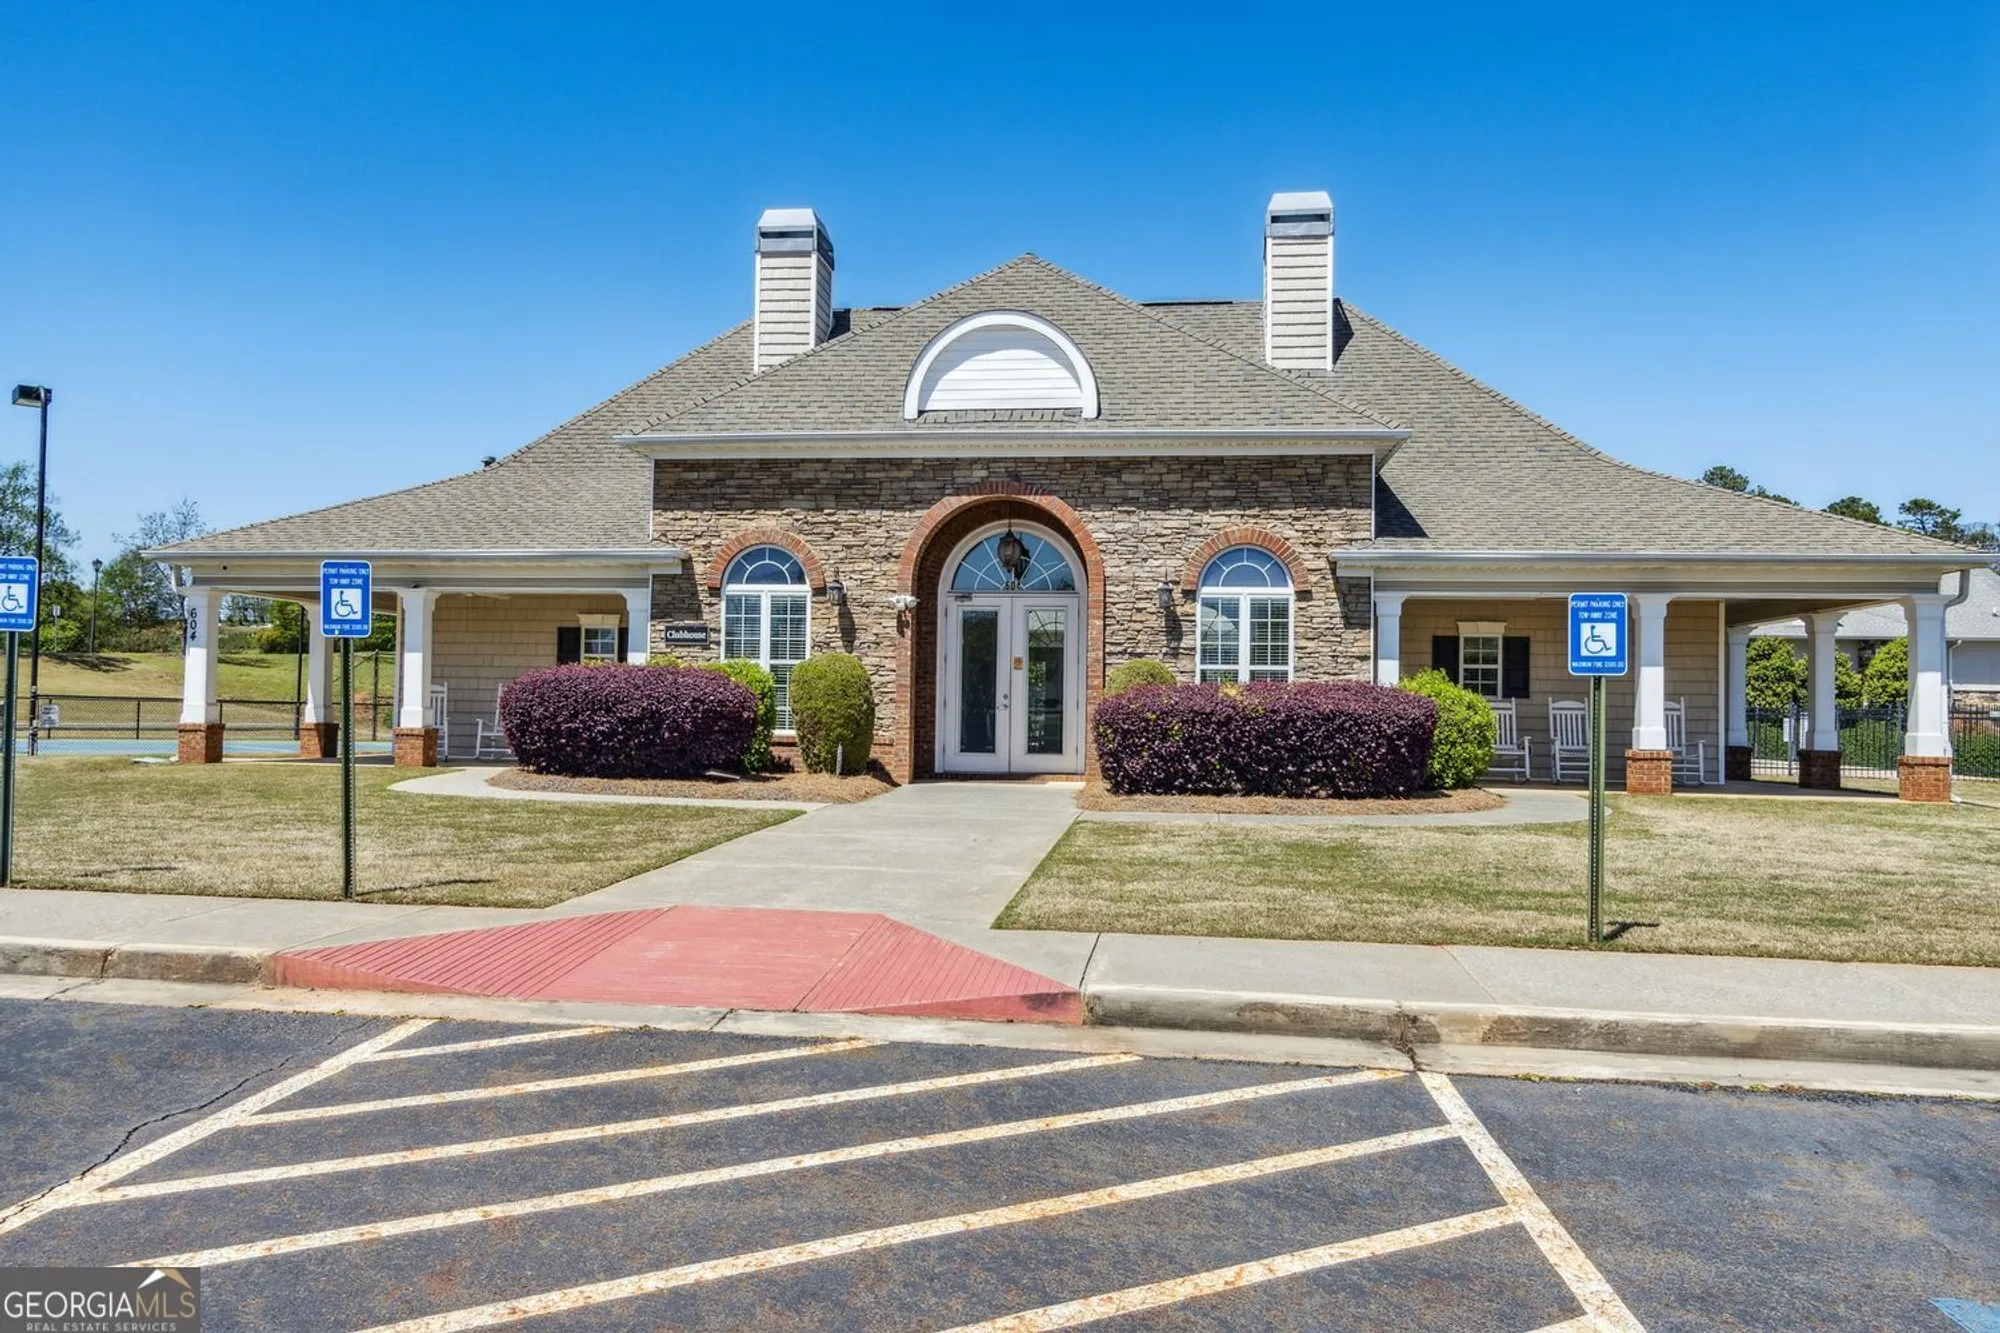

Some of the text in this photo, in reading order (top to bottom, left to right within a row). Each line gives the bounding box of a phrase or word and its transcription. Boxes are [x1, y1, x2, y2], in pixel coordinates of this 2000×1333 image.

[351, 578, 363, 586] ZONE
[1571, 600, 1588, 608] PERMIT
[1590, 600, 1611, 608] PARKING
[1579, 611, 1618, 619] TOW-AWAY ZONE
[190, 607, 198, 641] 604
[666, 630, 707, 639] Clubhouse
[1593, 661, 1603, 669] FINE
